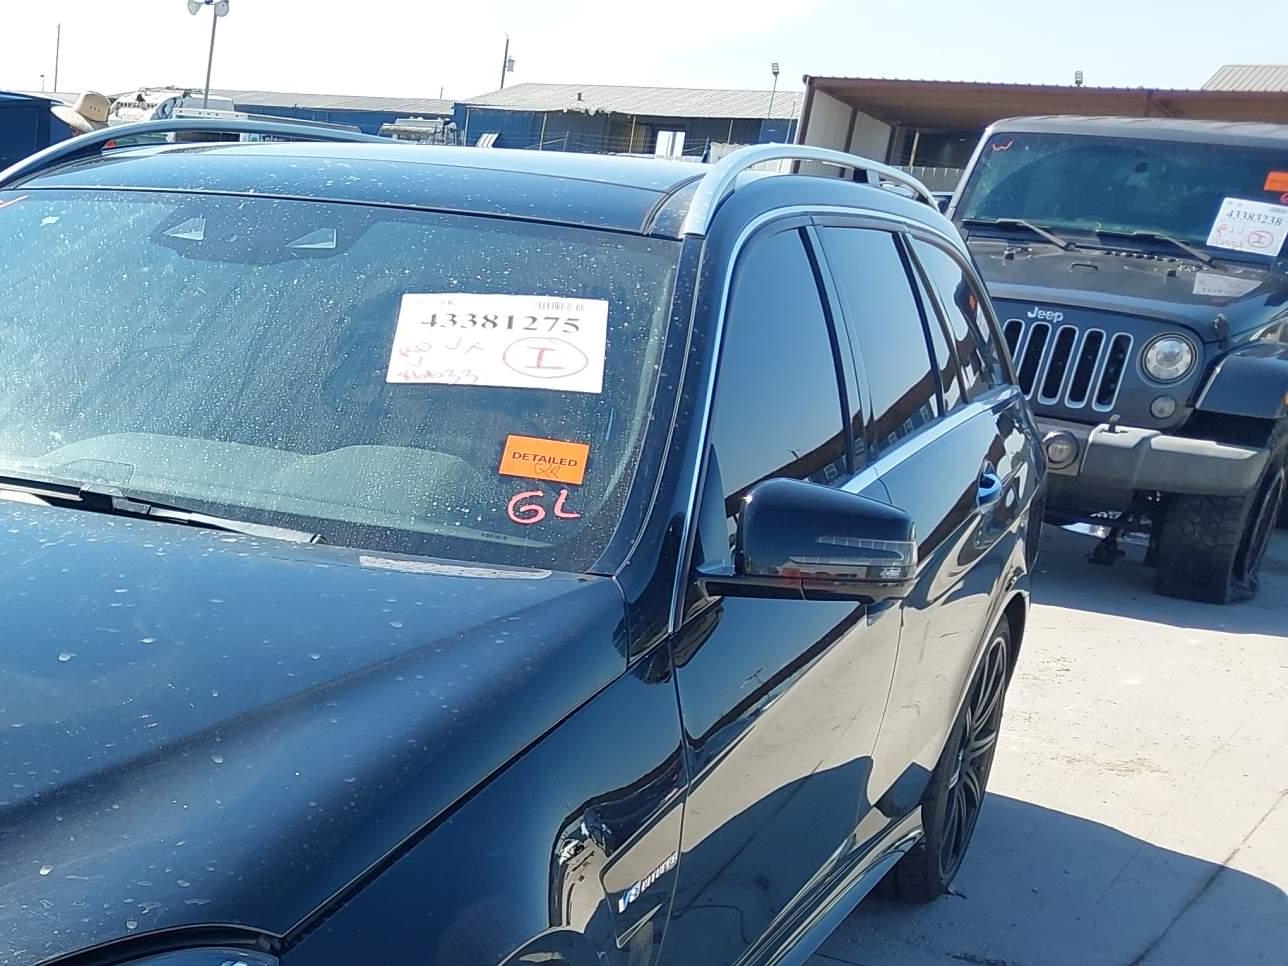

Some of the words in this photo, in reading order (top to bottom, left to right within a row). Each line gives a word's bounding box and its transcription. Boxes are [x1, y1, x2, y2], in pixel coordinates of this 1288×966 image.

[420, 313, 581, 333] 43381275
[1027, 306, 1064, 323] Jeep
[512, 451, 578, 467] DETAILED
